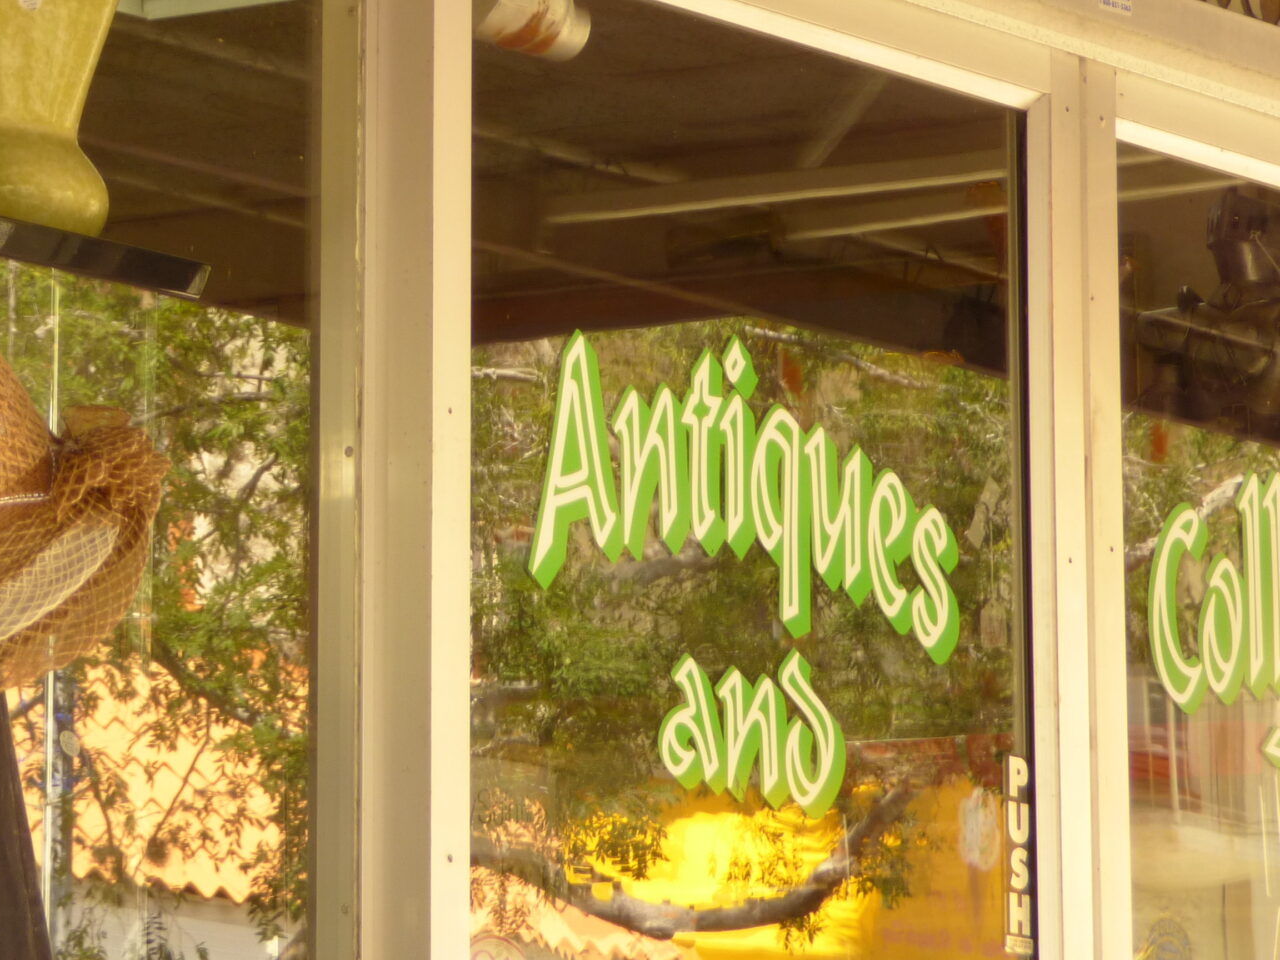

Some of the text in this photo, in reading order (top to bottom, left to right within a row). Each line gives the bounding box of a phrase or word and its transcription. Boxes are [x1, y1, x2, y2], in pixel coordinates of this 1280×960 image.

[528, 328, 960, 665] Antiques
[657, 647, 846, 818] and
[1008, 755, 1031, 937] PUSH
